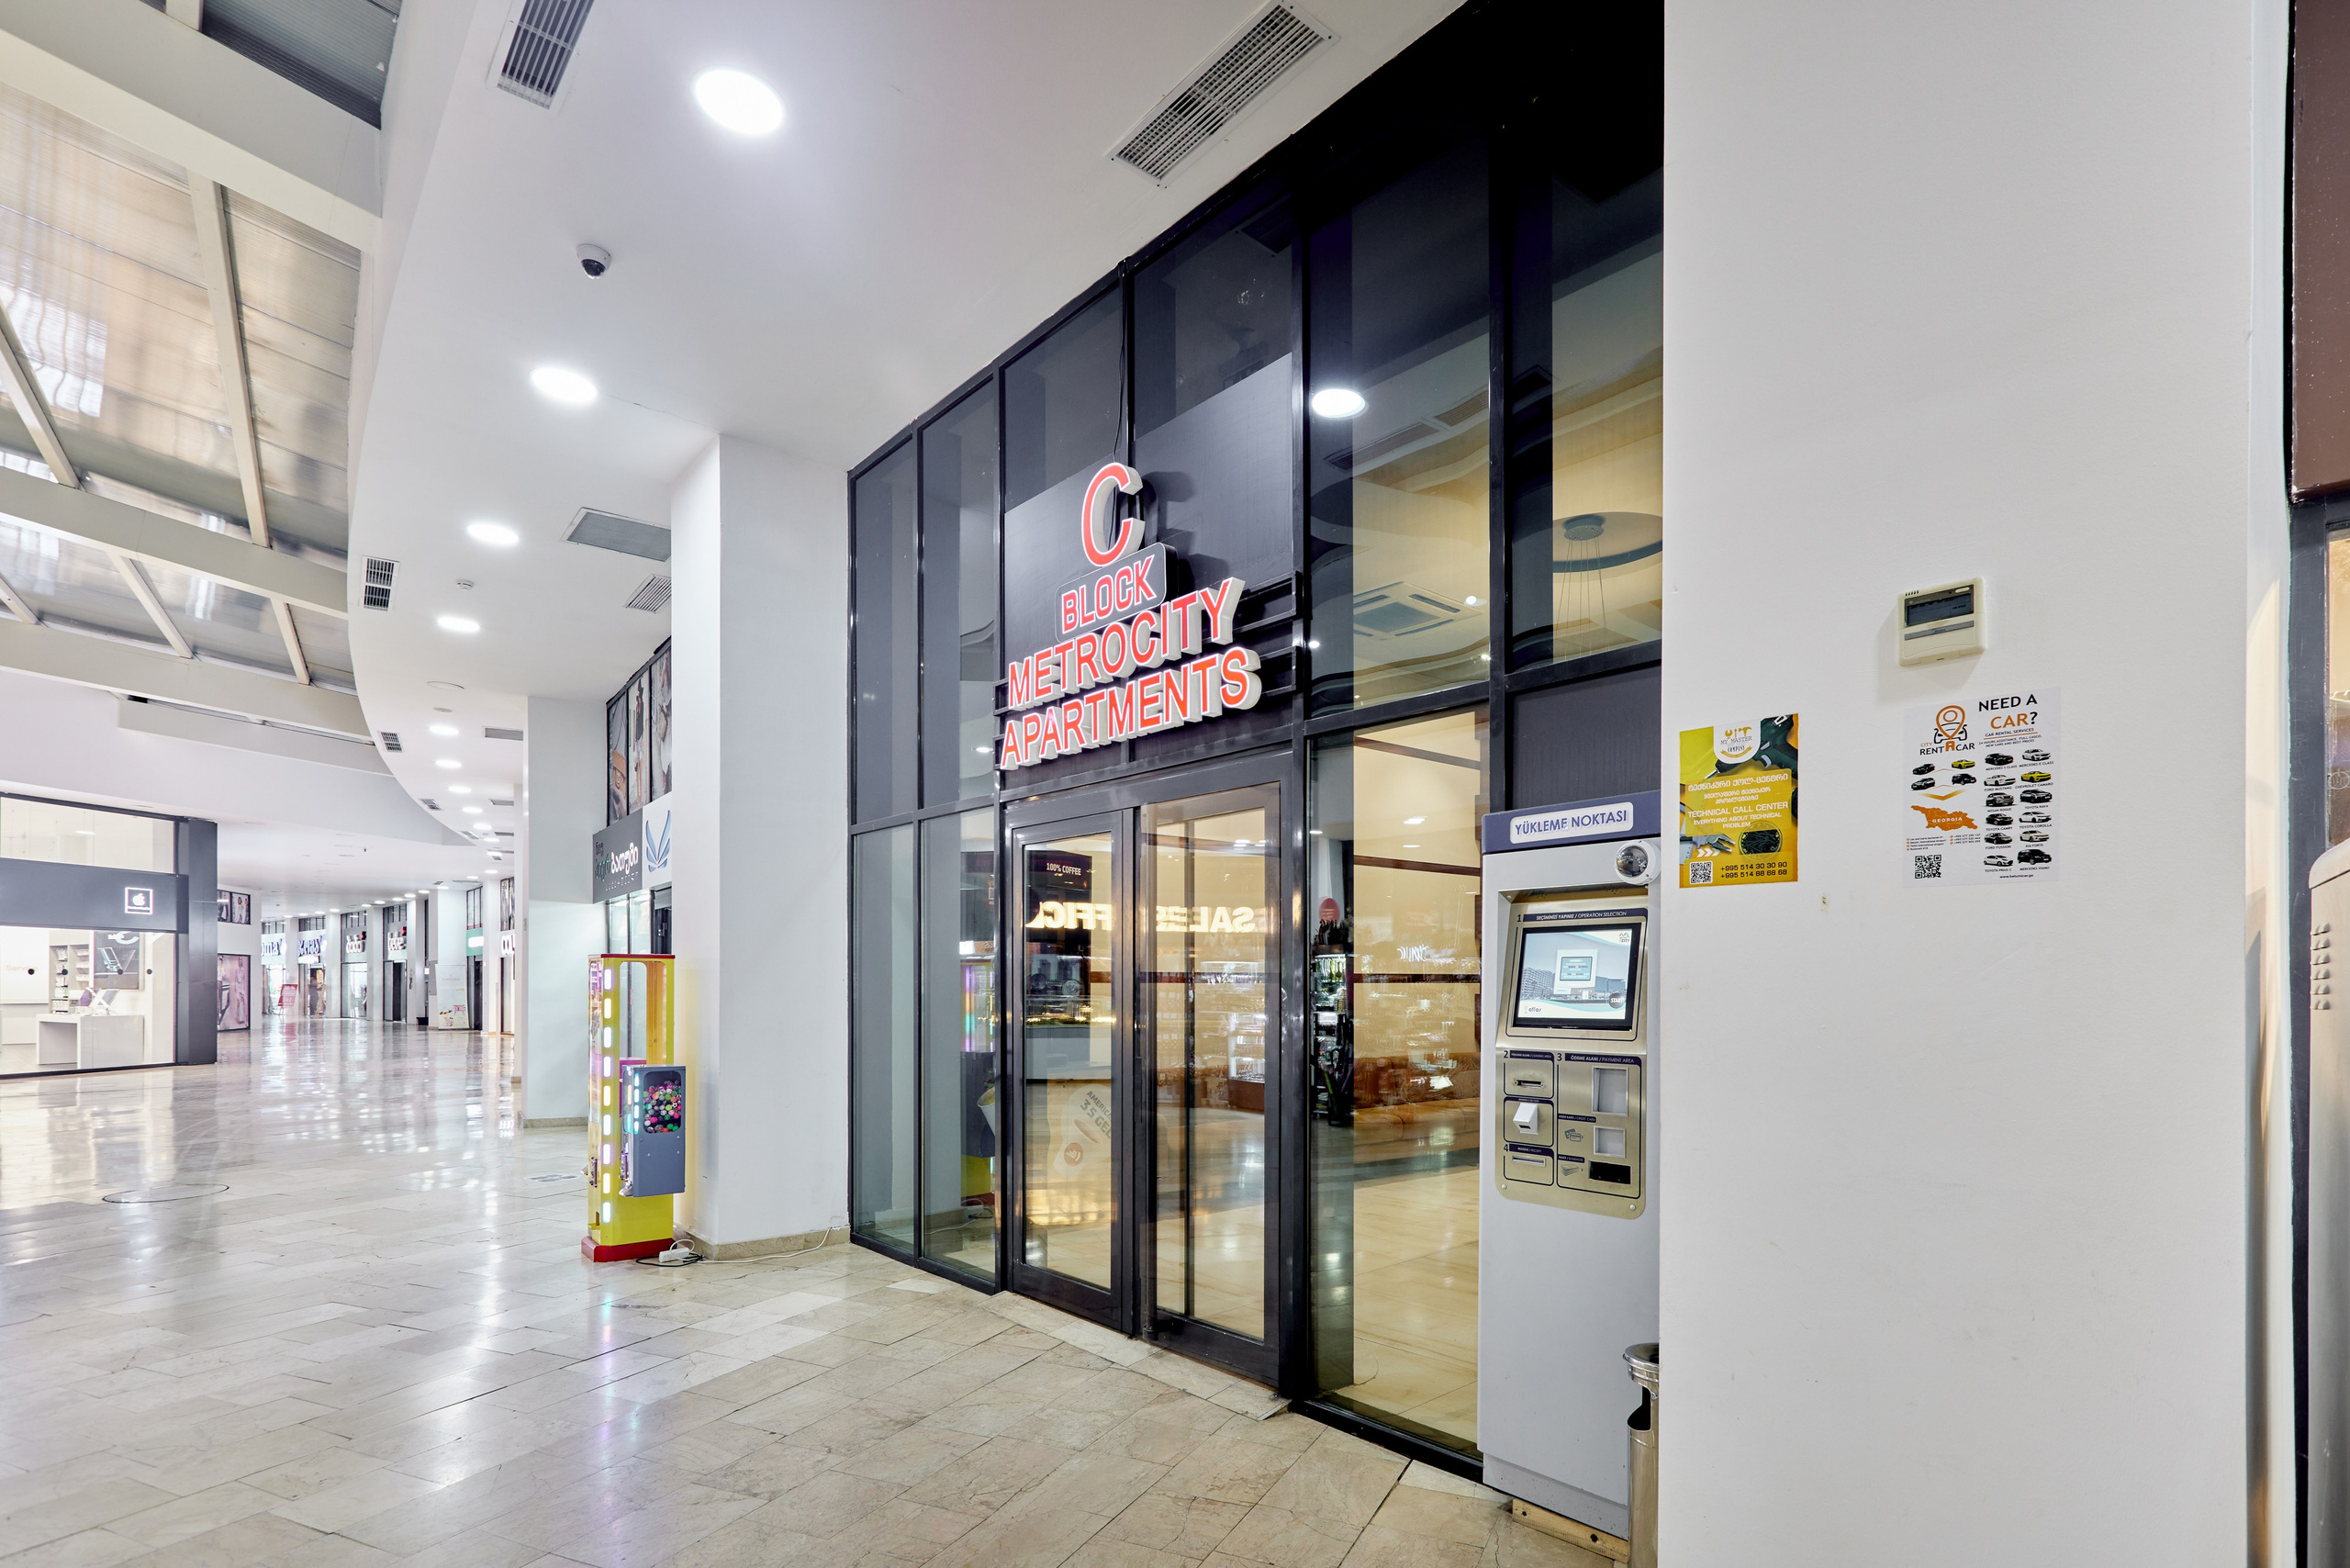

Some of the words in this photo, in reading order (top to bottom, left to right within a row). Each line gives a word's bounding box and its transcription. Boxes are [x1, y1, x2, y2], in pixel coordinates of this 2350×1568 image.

[1081, 463, 1144, 566] C
[1061, 554, 1157, 635] BLOCK
[1009, 577, 1243, 709] METROCITY
[1001, 647, 1261, 769] APARTMENTS
[1978, 696, 2021, 711] NEED
[2026, 693, 2038, 706] A
[1990, 711, 2038, 729] CAR?
[1919, 746, 1944, 756] RENT
[1955, 743, 1975, 752] CAR
[1687, 808, 1730, 818] TECHNICAL
[1732, 806, 1753, 814] CALL
[1755, 801, 1789, 812] CENTER
[1572, 810, 1627, 827] NOKTASI
[1694, 817, 1728, 825] EVERYTHING
[1749, 812, 1783, 821] TECHNICAL
[1046, 863, 1061, 872] 100%
[1062, 865, 1082, 876] COFFEE
[1516, 914, 1522, 923] 1
[1504, 1050, 1508, 1058] 2
[1557, 1053, 1562, 1061] 3
[1504, 1144, 1509, 1152] 4
